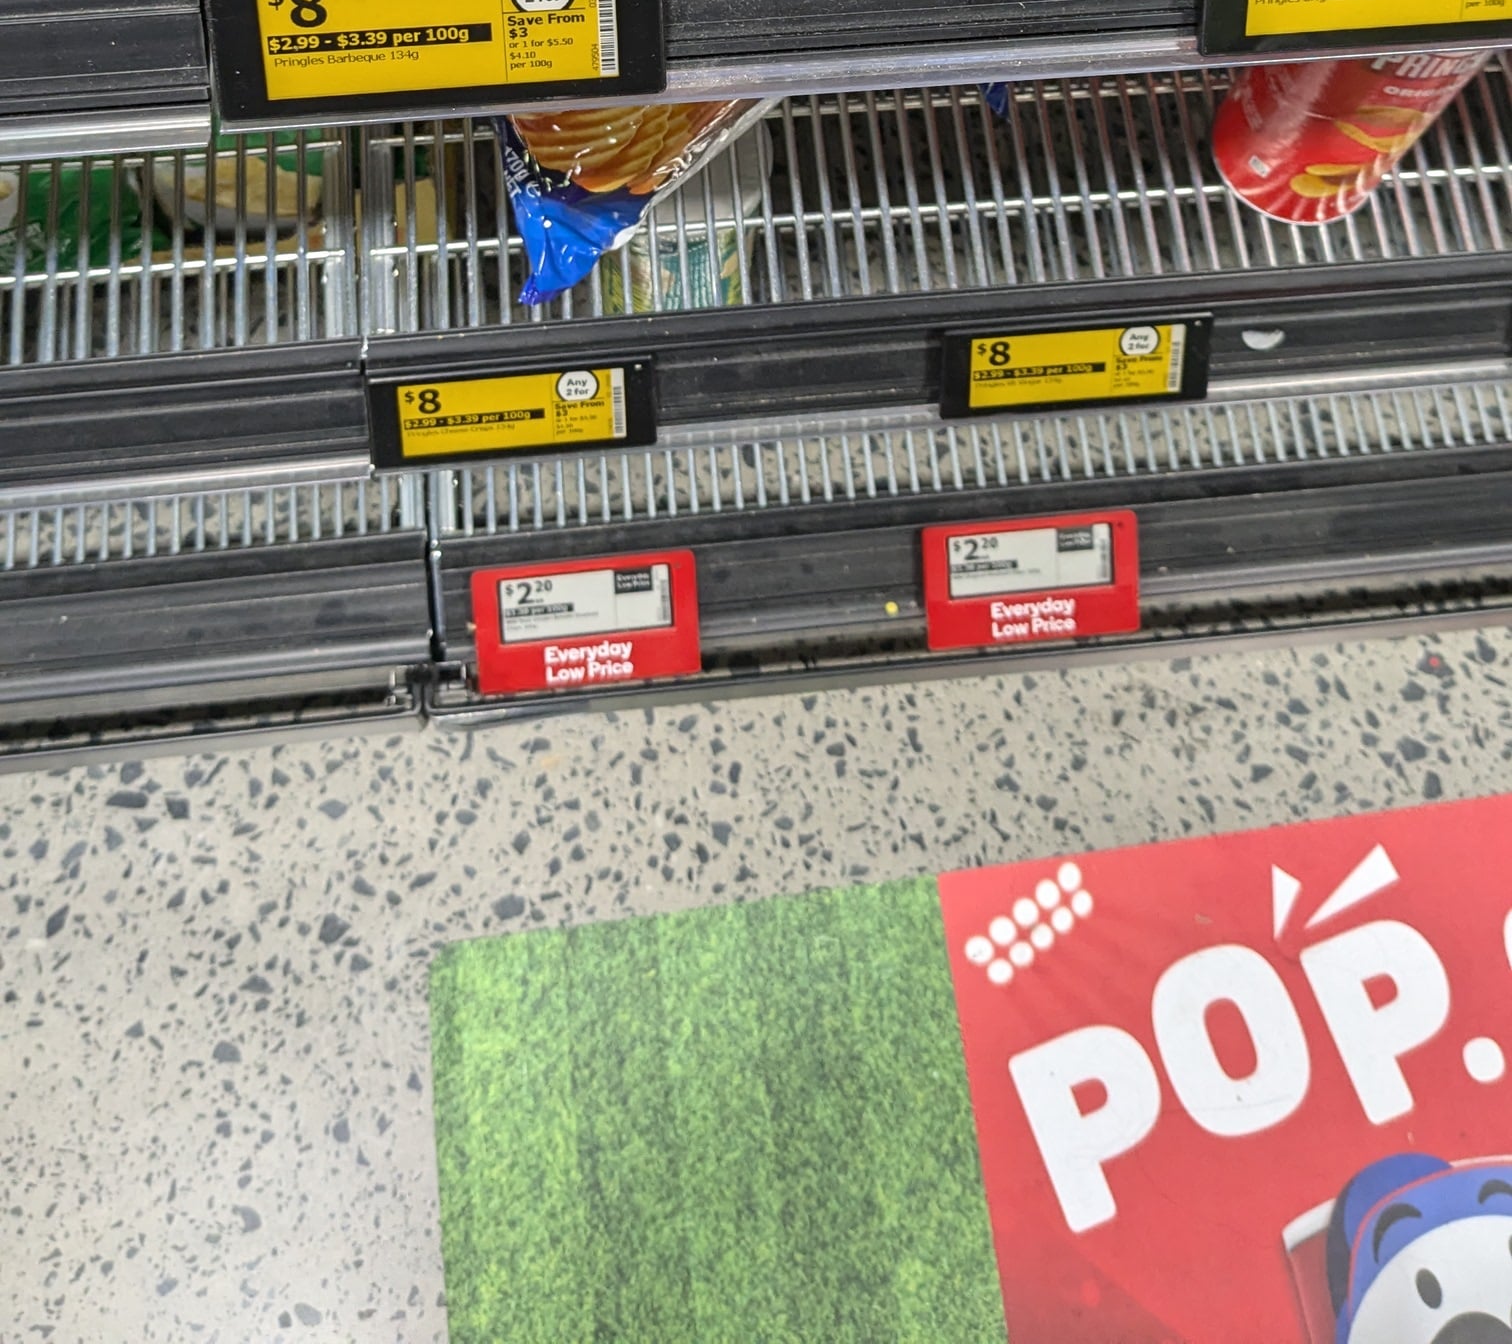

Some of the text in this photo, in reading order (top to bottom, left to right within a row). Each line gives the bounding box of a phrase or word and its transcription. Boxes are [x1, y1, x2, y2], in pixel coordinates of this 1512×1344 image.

[507, 10, 585, 28] Save From
[268, 26, 469, 54] $2.99 $3.39 per 100g
[509, 25, 529, 40] $3
[531, 38, 544, 48] for
[547, 36, 574, 48] $5.50
[274, 48, 420, 70] Pringles Barbeque 134g
[509, 50, 537, 61] $4.10
[510, 59, 553, 71] per 100g
[567, 377, 587, 389] Any
[481, 413, 501, 424] per
[503, 410, 531, 422] 100g
[990, 597, 1076, 620] Everyday
[992, 616, 1076, 638] Low Price
[544, 641, 632, 665] Everyday
[546, 660, 633, 683] Low Price
[1008, 919, 1505, 1234] POP.
